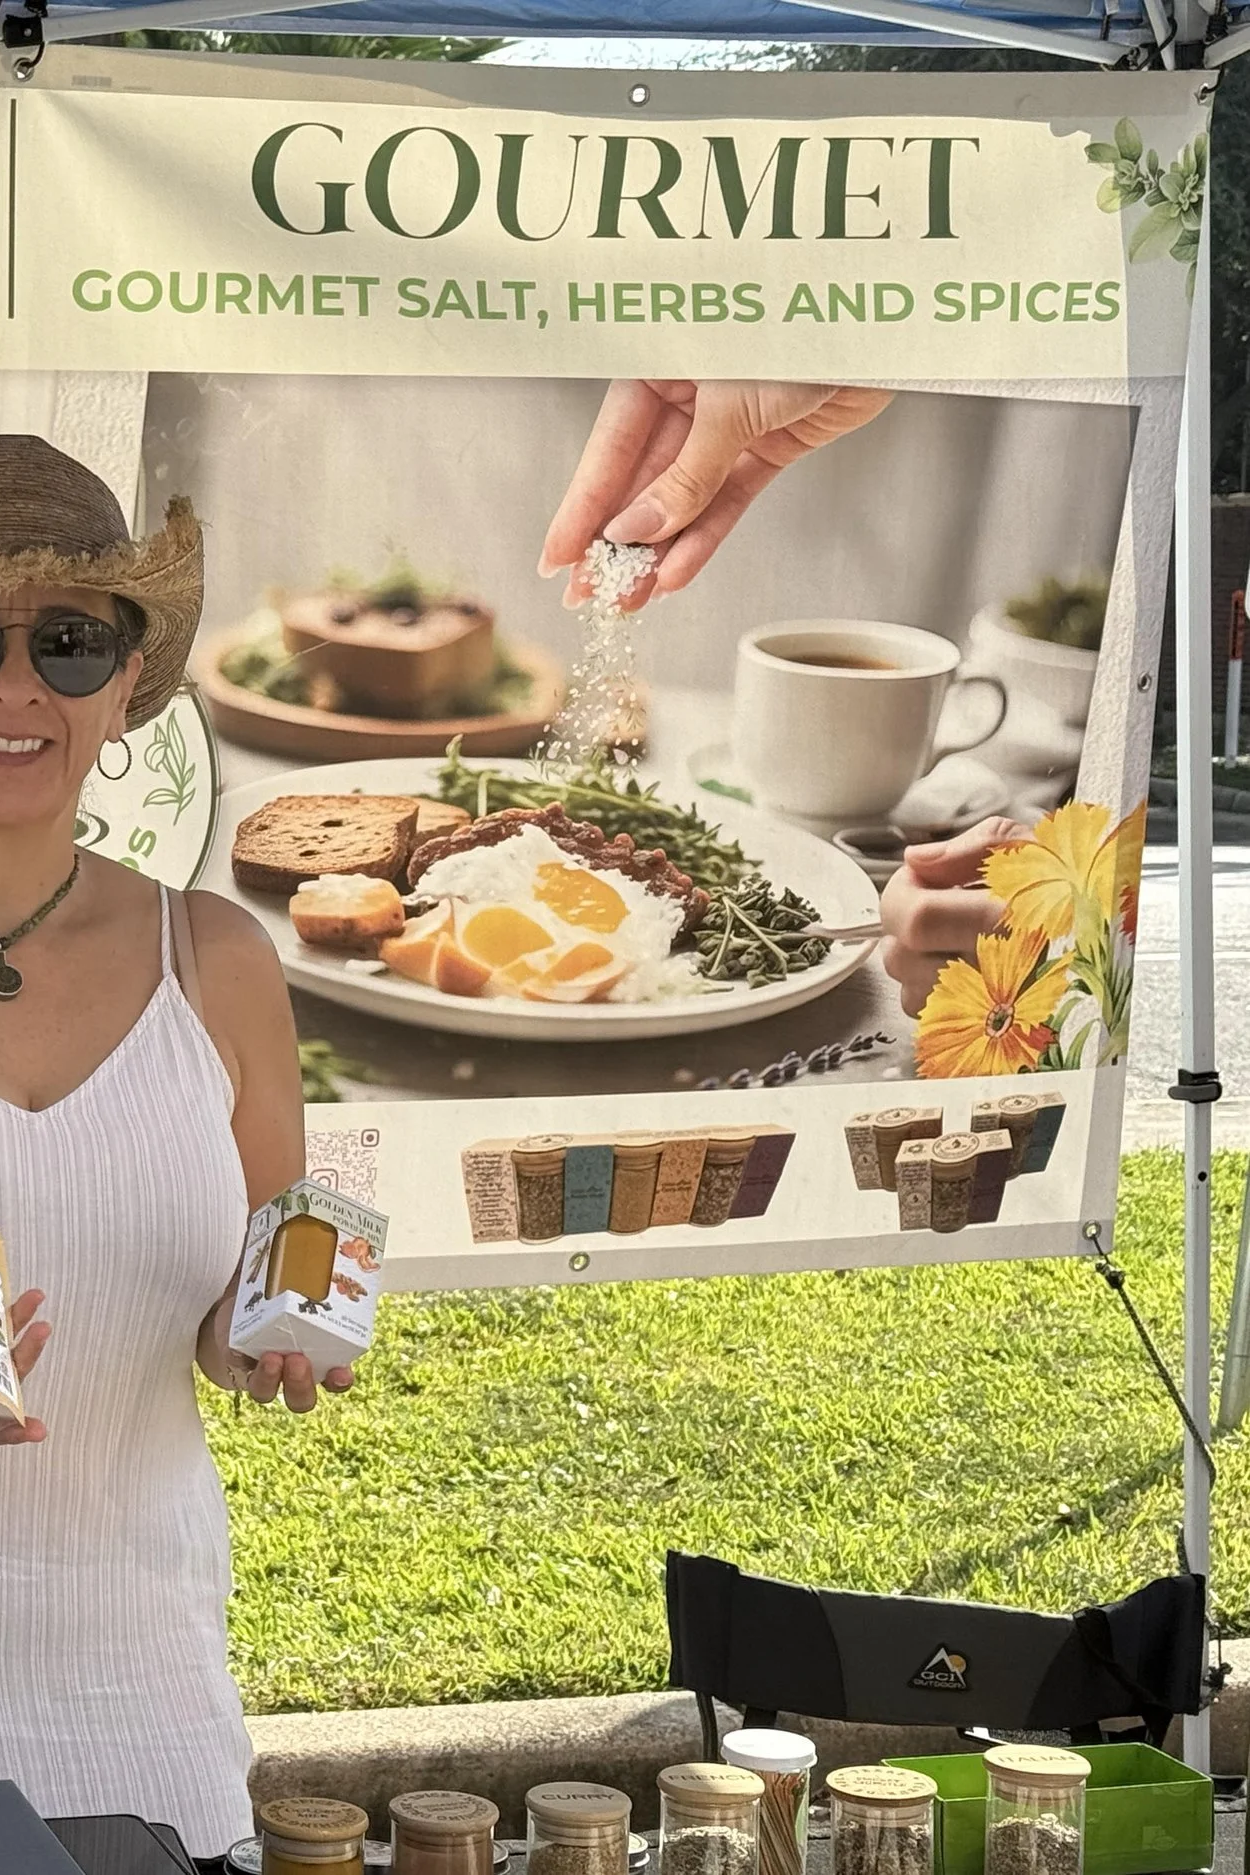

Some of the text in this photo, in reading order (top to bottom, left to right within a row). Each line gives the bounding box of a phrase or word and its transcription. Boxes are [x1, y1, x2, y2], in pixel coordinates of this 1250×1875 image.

[251, 122, 980, 241] GOURMET
[72, 269, 1121, 329] GOURMET SALT, HERBS AND SPICES
[310, 1193, 383, 1235] GOLDEN MILK
[913, 1678, 962, 1688] OUTDOOR
[921, 1671, 955, 1682] GCI
[541, 1793, 616, 1801] CURRY
